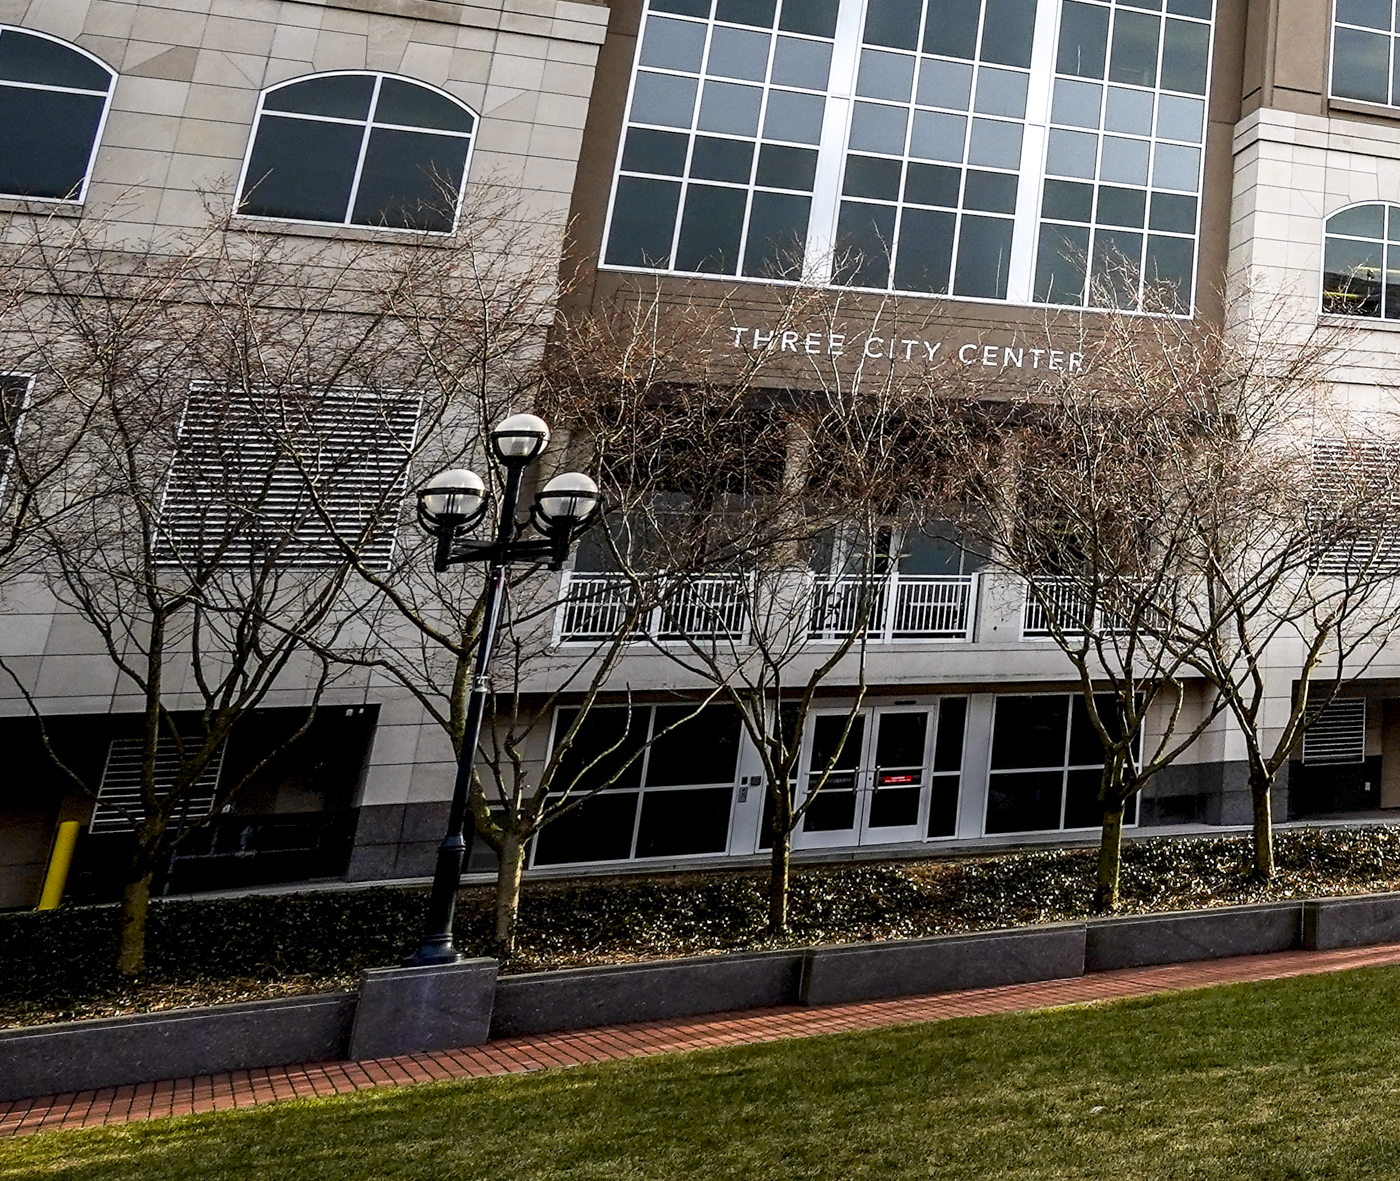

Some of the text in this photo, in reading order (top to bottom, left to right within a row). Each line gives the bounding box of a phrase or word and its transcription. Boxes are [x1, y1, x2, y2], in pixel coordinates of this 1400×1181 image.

[729, 326, 1085, 372] THREE CITY CENTER
